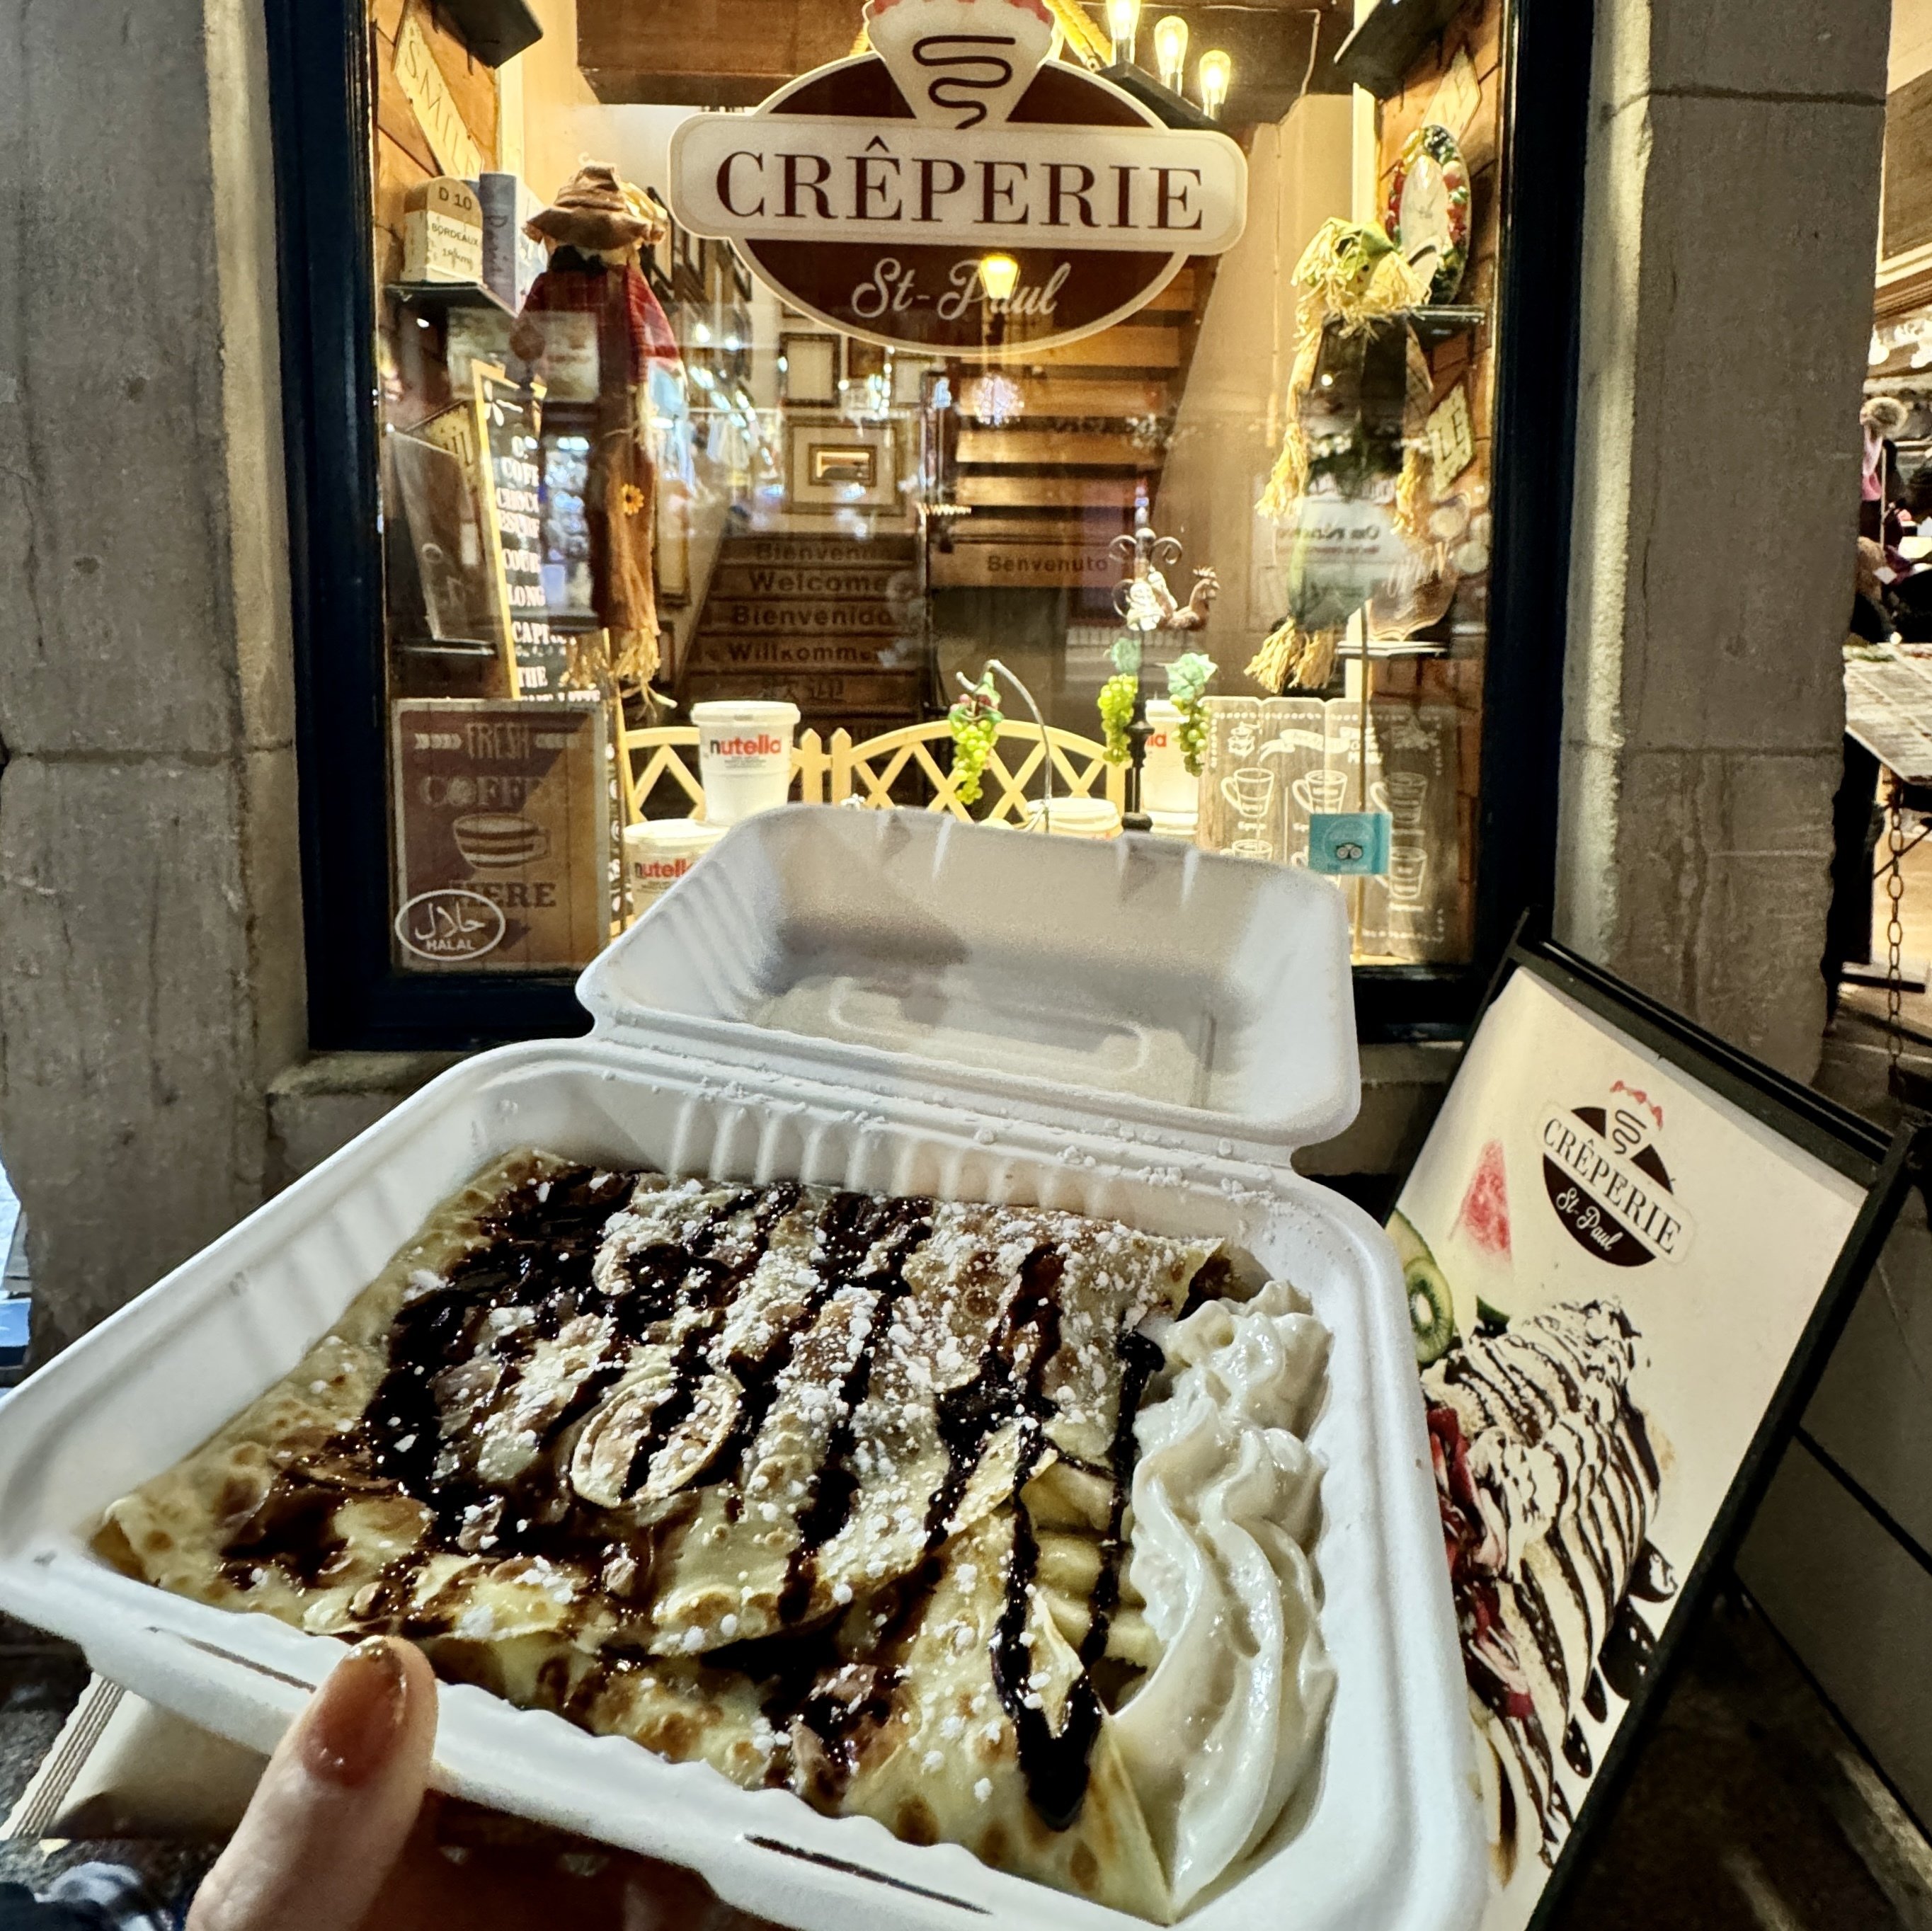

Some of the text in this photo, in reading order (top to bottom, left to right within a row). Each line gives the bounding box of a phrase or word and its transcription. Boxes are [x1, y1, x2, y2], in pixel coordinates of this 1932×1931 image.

[716, 135, 1203, 231] CRÊPERIE
[438, 186, 472, 211] D 10
[431, 222, 479, 247] BORDEAUX
[987, 554, 1109, 573] Benvenuto
[748, 571, 887, 592] Welcome
[734, 605, 893, 626] Bienvenido
[465, 722, 531, 760] FRESH
[709, 733, 782, 755] nutella
[413, 901, 486, 941] حلال
[425, 938, 476, 952] HALAL
[1543, 1118, 1682, 1255] CRÊPERIE
[1556, 1186, 1624, 1252] St-Paul
